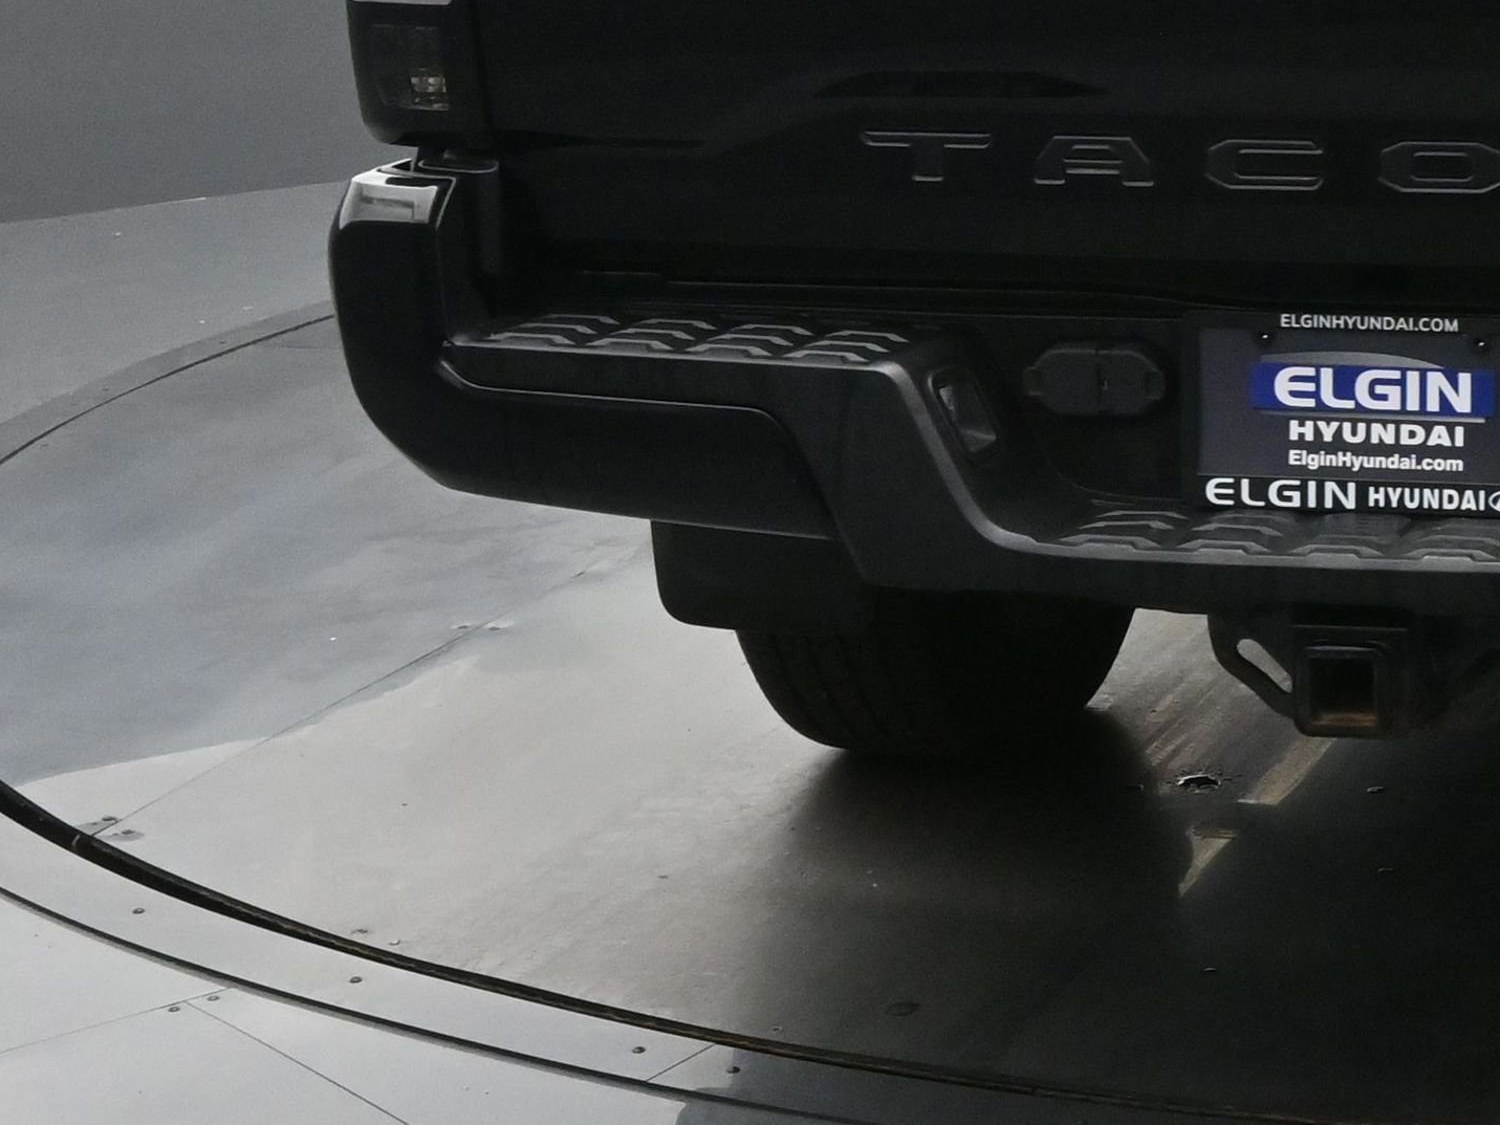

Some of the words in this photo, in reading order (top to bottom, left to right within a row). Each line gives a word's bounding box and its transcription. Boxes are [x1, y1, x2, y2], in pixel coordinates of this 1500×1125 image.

[1280, 314, 1458, 332] ELGINHYUNDAI.COM
[1274, 366, 1472, 413] ELGIN
[1288, 420, 1465, 447] HYUNDAI
[1288, 450, 1464, 472] ElginHyundai.com
[1205, 478, 1356, 509] ELGIN
[1368, 486, 1485, 511] HYUNDAI
